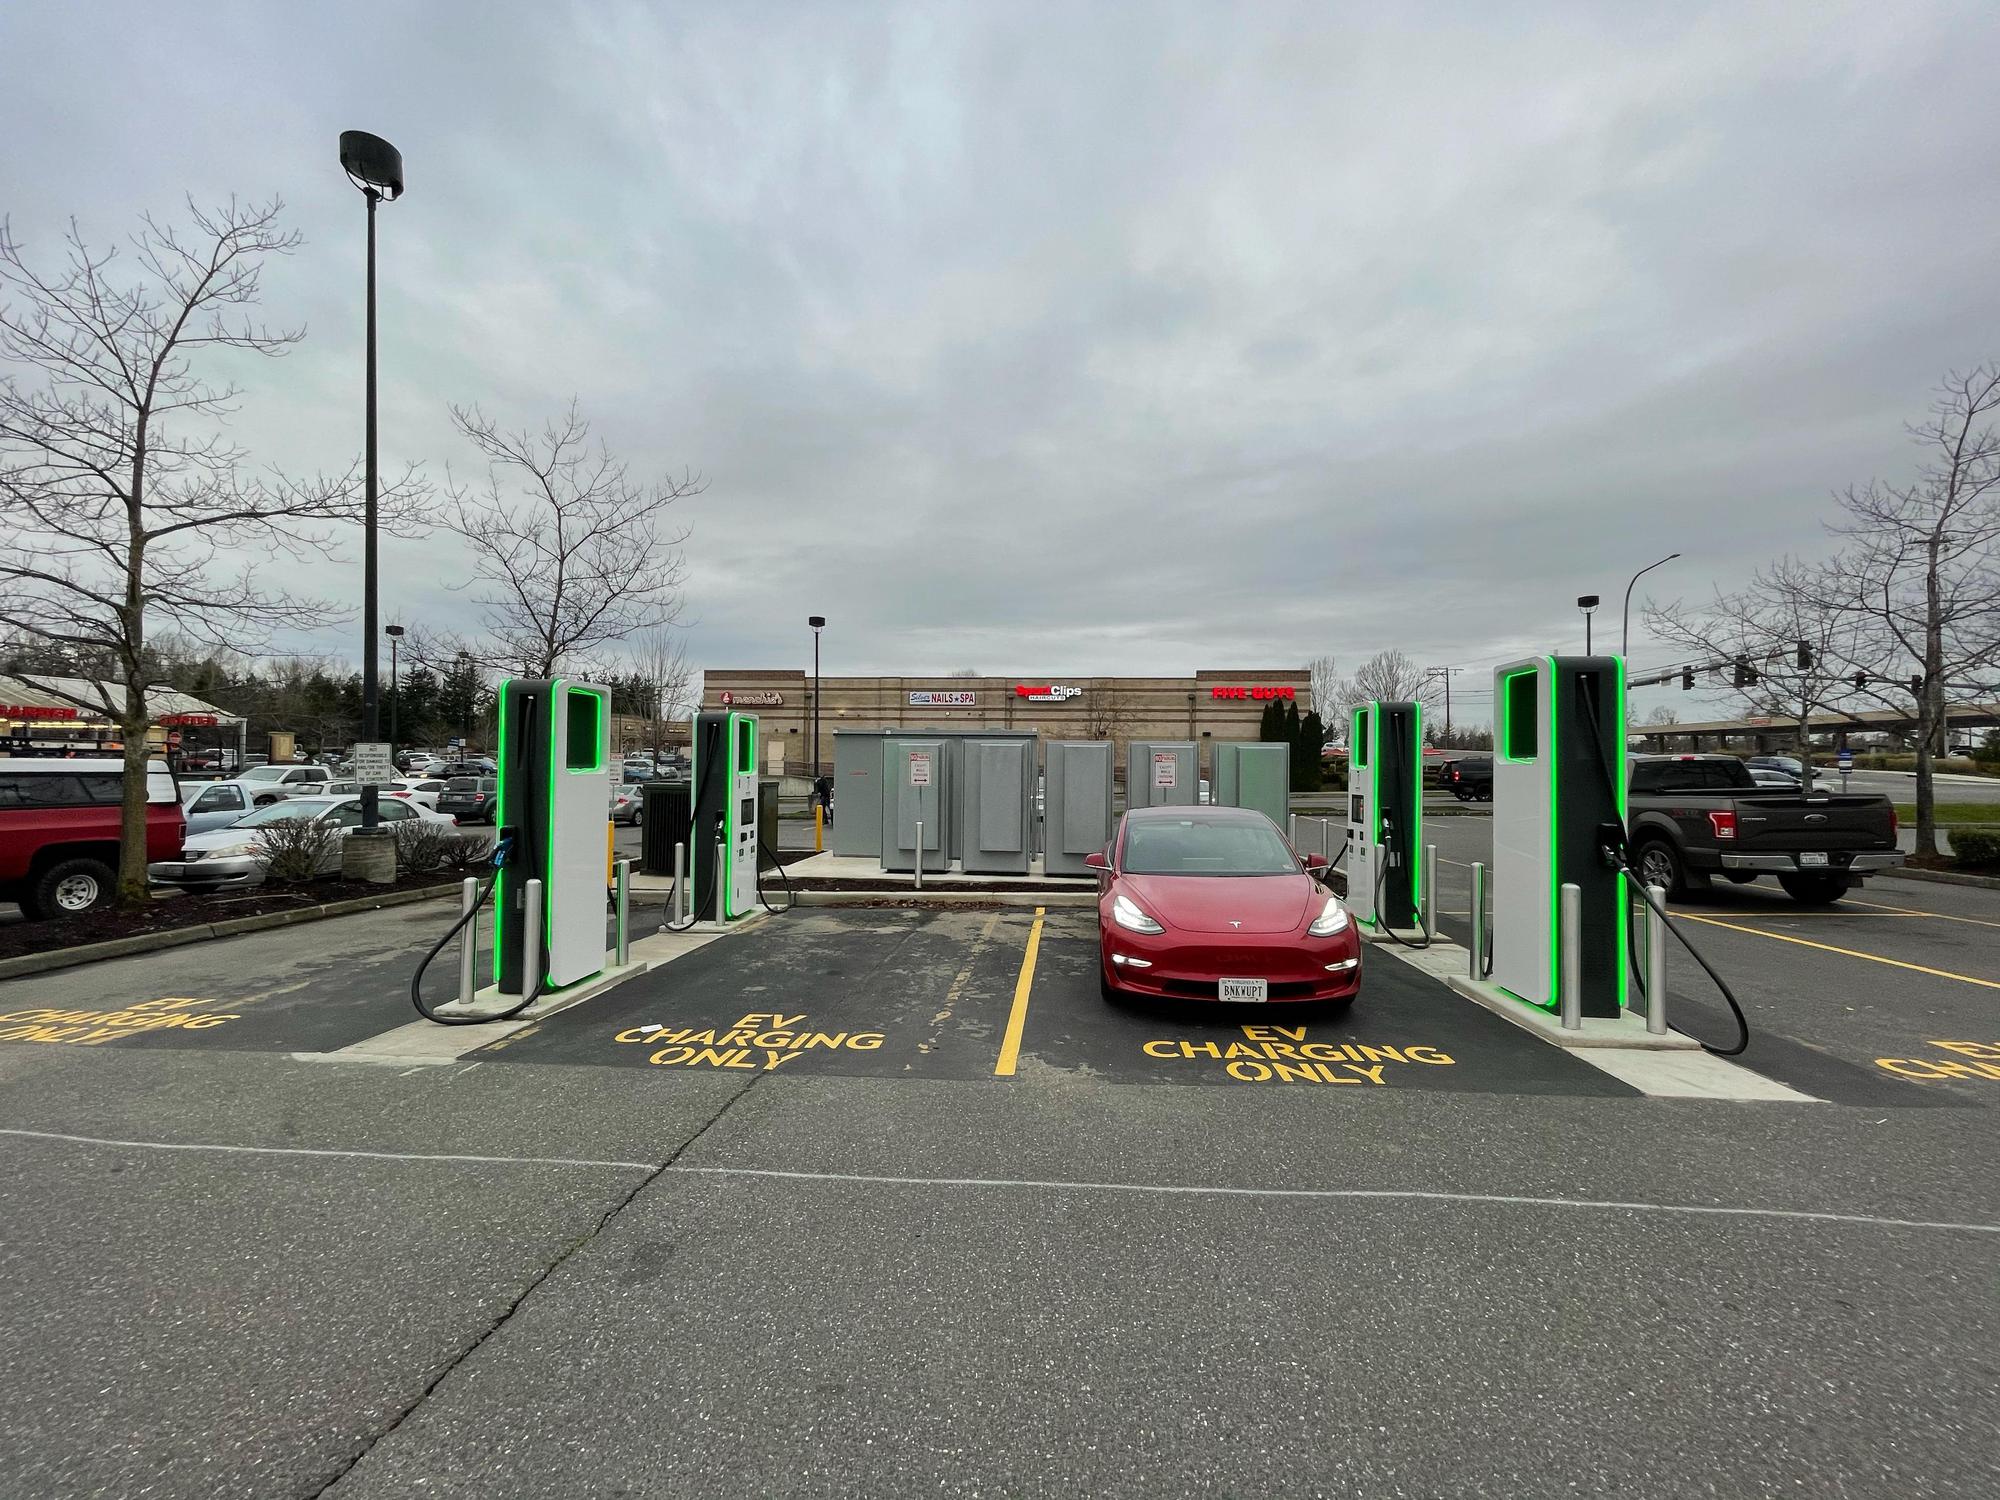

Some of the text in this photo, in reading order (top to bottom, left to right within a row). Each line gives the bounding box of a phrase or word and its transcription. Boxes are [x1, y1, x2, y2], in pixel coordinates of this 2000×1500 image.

[931, 693, 953, 703] NAILS
[959, 693, 975, 703] SPA
[1212, 687, 1295, 700] FIVE GUYS
[1224, 985, 1262, 997] BNKWUPT
[732, 1013, 807, 1029] EV
[614, 1025, 886, 1050] CHARGING
[1241, 1025, 1307, 1041] EV
[649, 1046, 804, 1071] ONLY
[1142, 1040, 1456, 1065] CHARGING
[1225, 1061, 1386, 1085] ONLY
